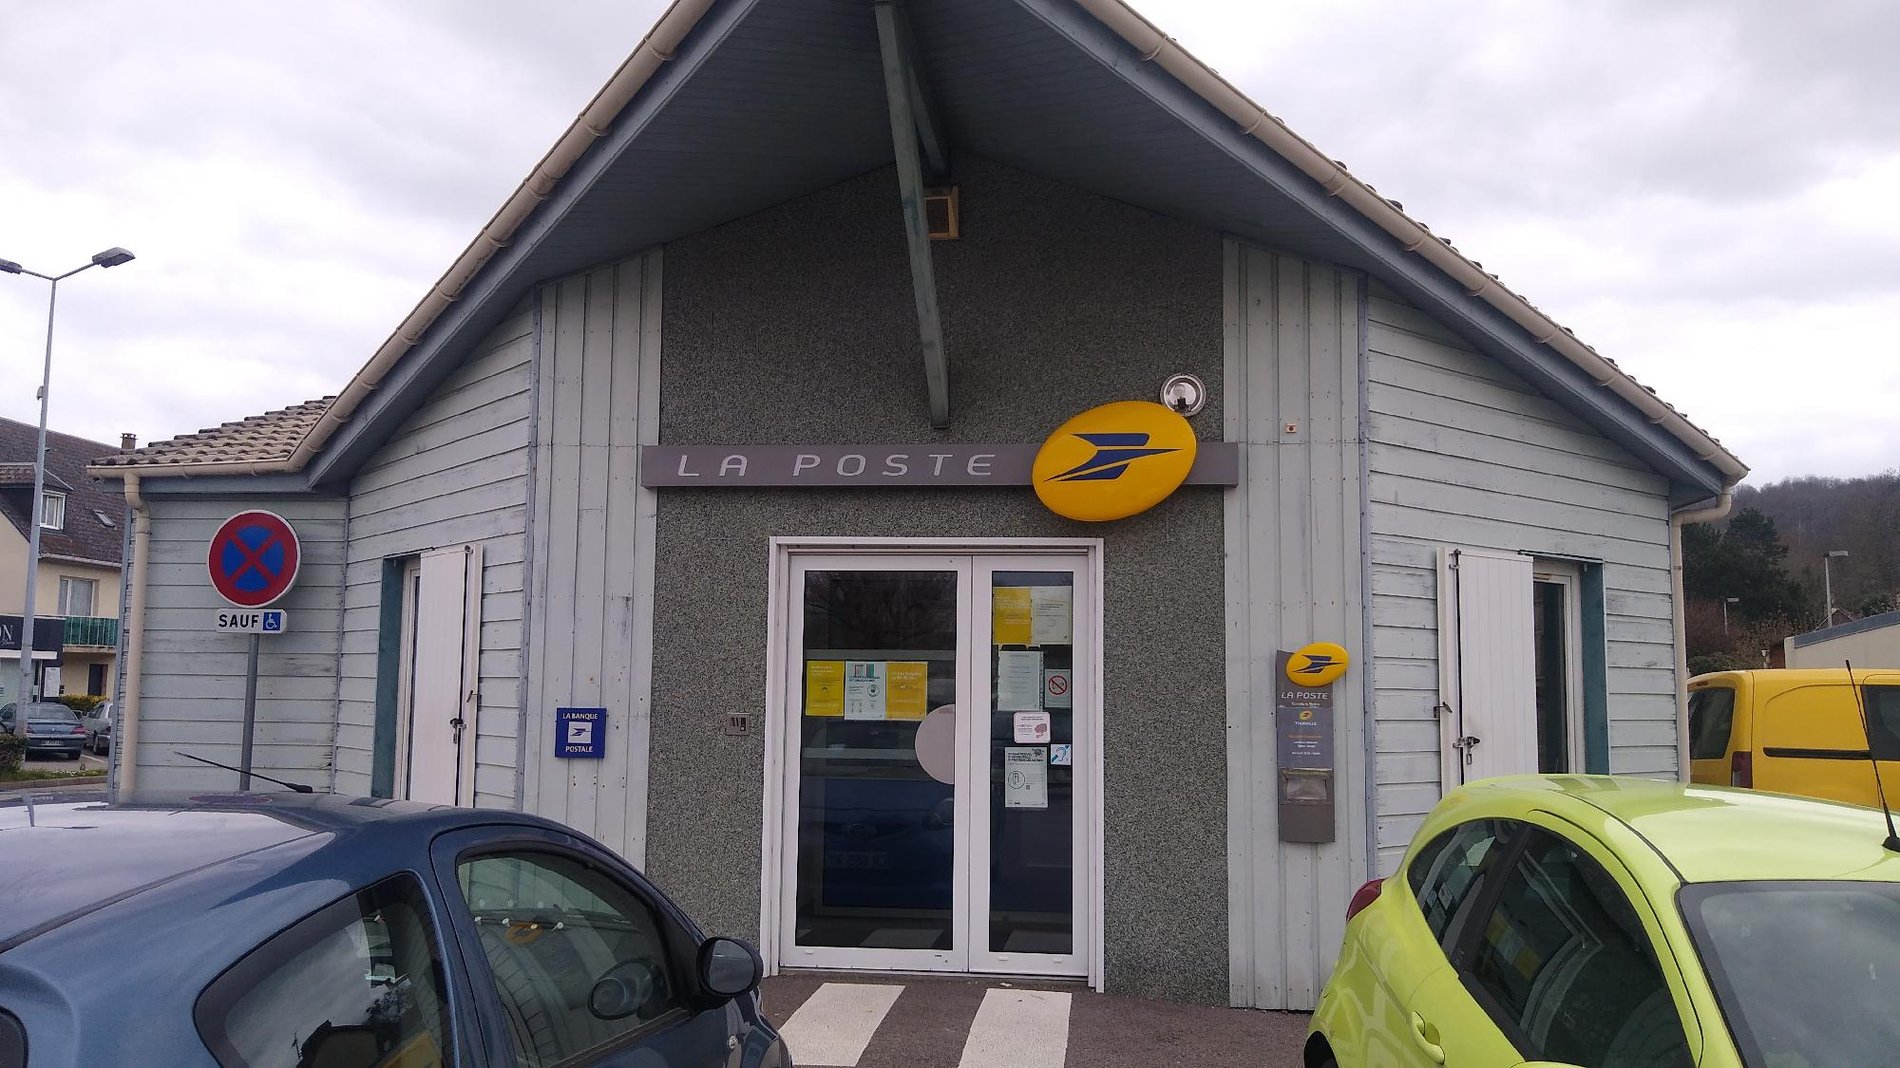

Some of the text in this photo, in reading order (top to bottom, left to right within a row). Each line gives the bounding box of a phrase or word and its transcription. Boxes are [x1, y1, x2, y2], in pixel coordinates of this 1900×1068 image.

[677, 454, 996, 477] LA POSTE
[218, 613, 259, 628] SAUF
[1281, 691, 1329, 700] LA POSTE
[562, 712, 599, 720] LA BANQUE
[565, 745, 594, 753] POSTALE
